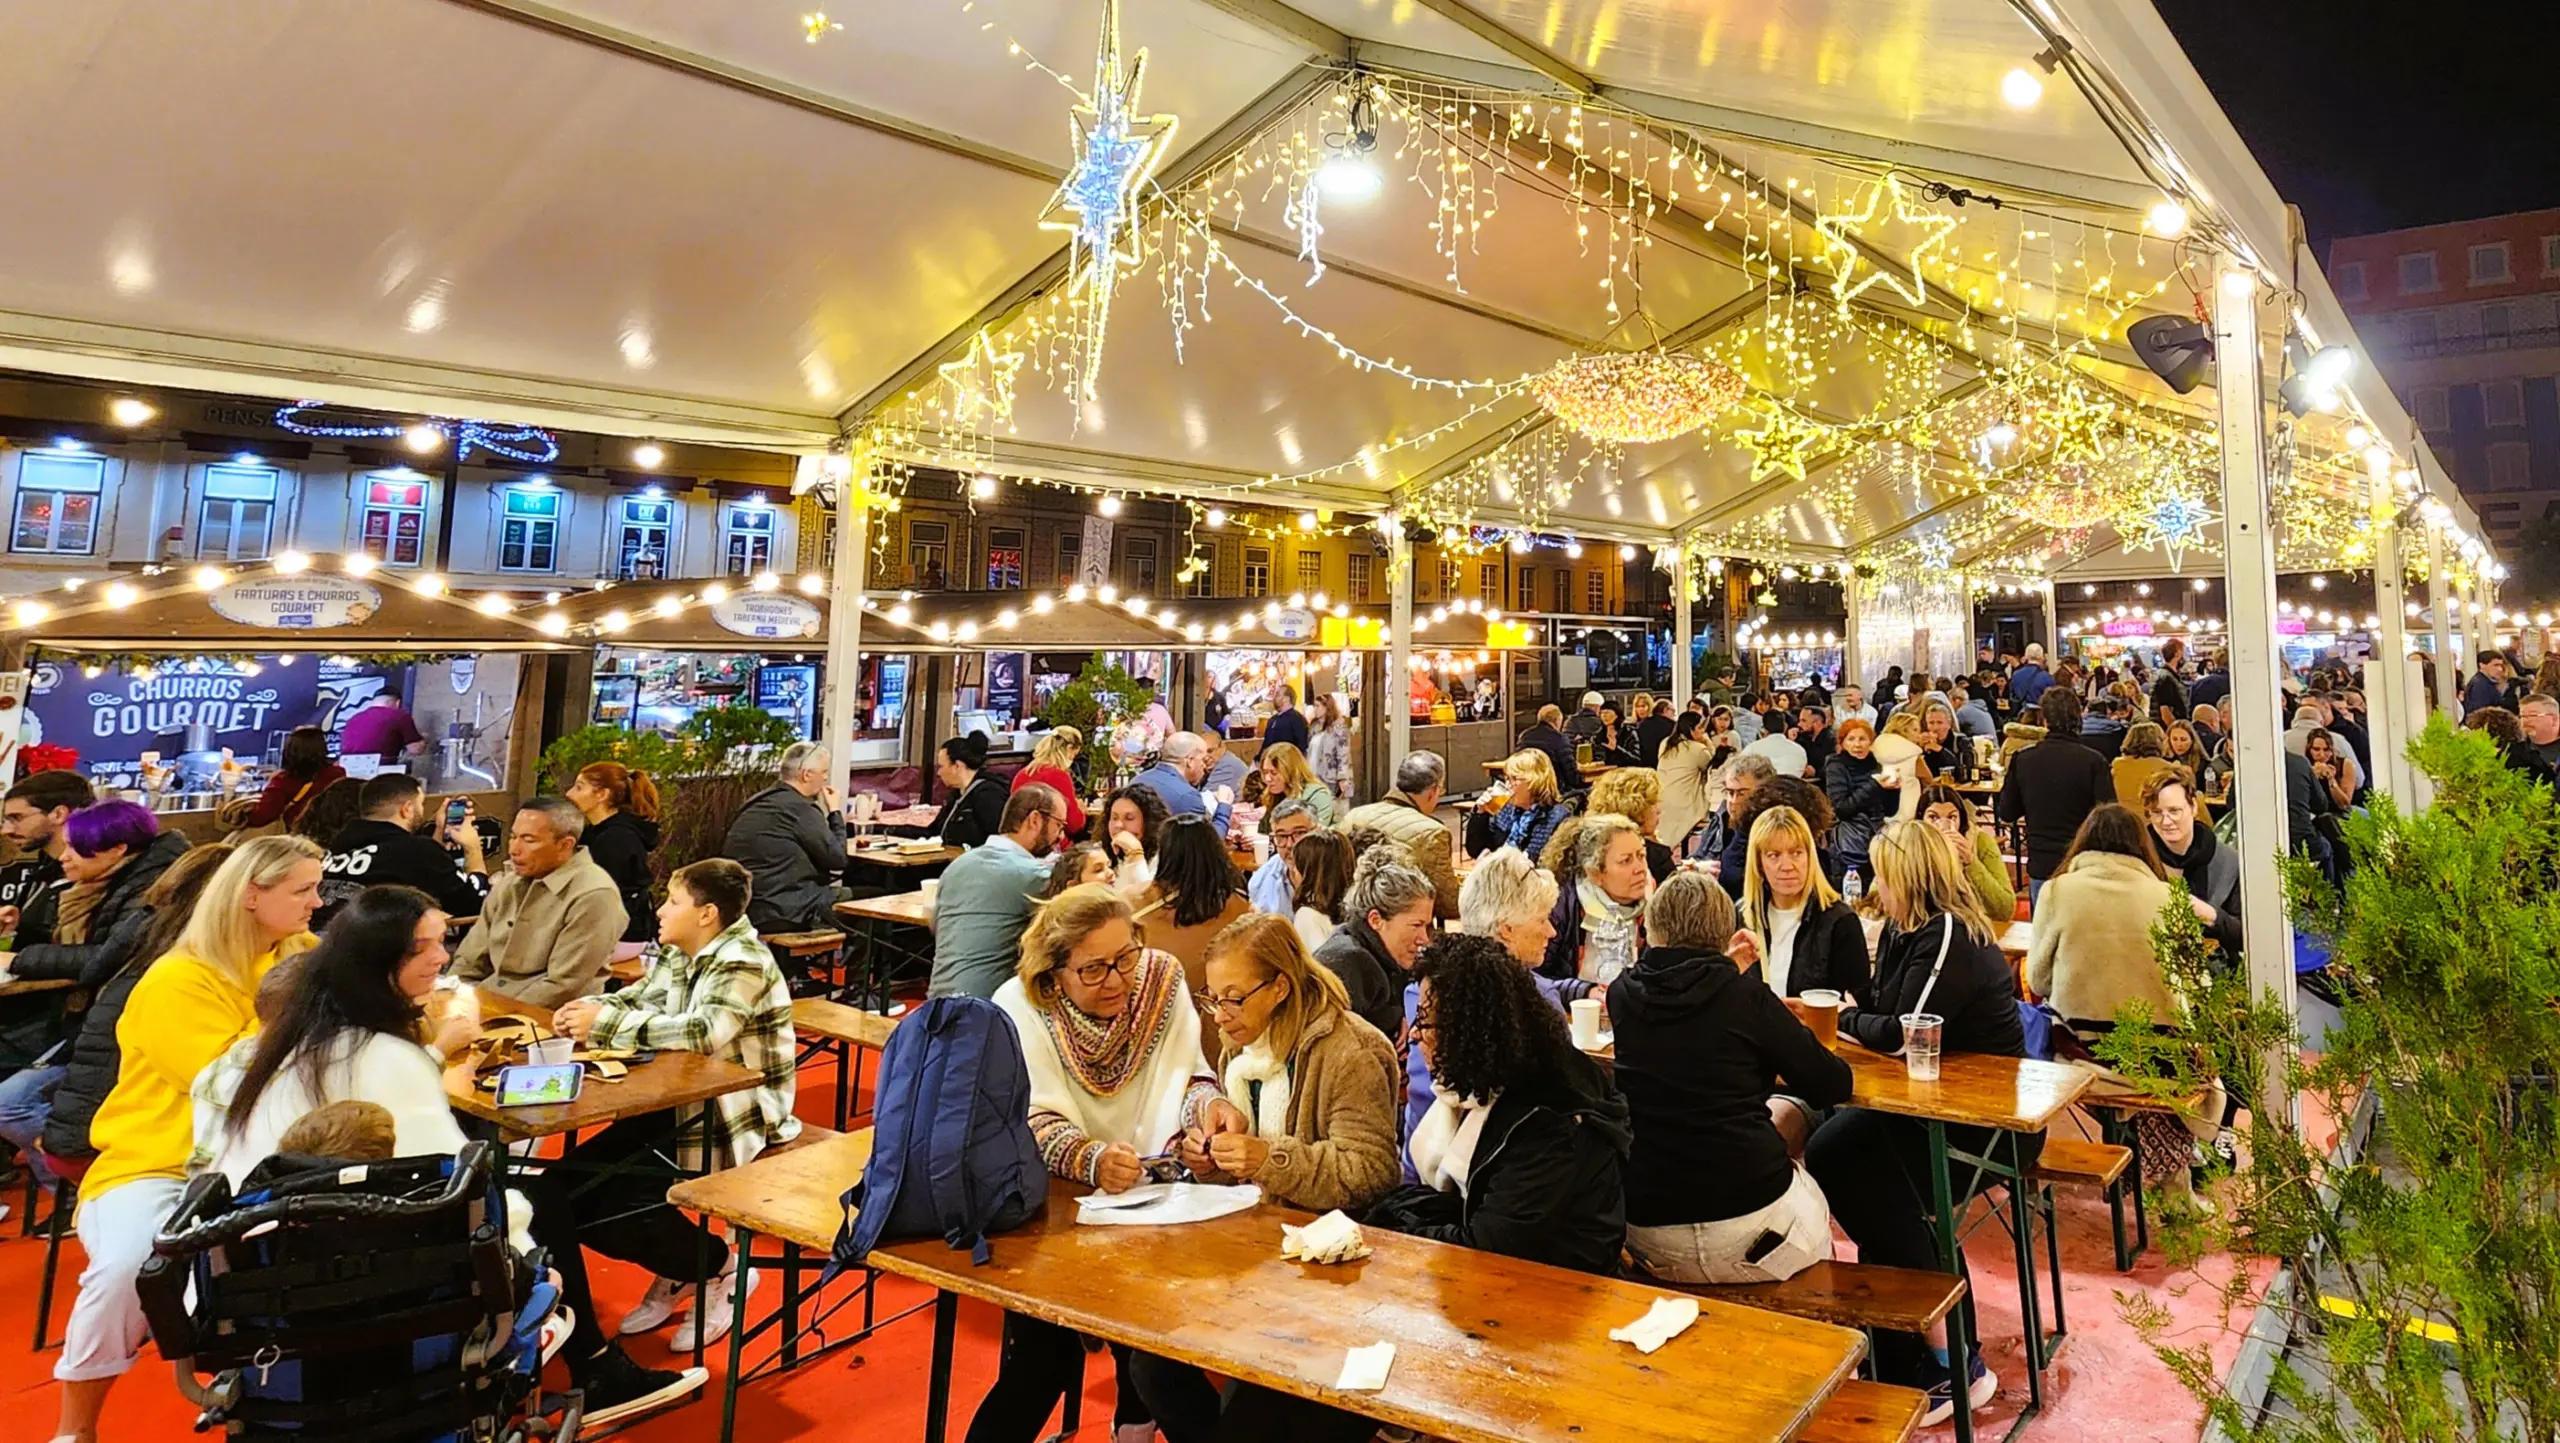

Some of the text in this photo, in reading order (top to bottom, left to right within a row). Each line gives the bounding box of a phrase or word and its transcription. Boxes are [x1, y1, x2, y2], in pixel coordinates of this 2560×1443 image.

[234, 589, 360, 601] FARTURAS E CHURROS
[271, 602, 324, 613] GOURMET
[129, 677, 243, 702] CHURROS
[93, 700, 271, 737] GOURMET
